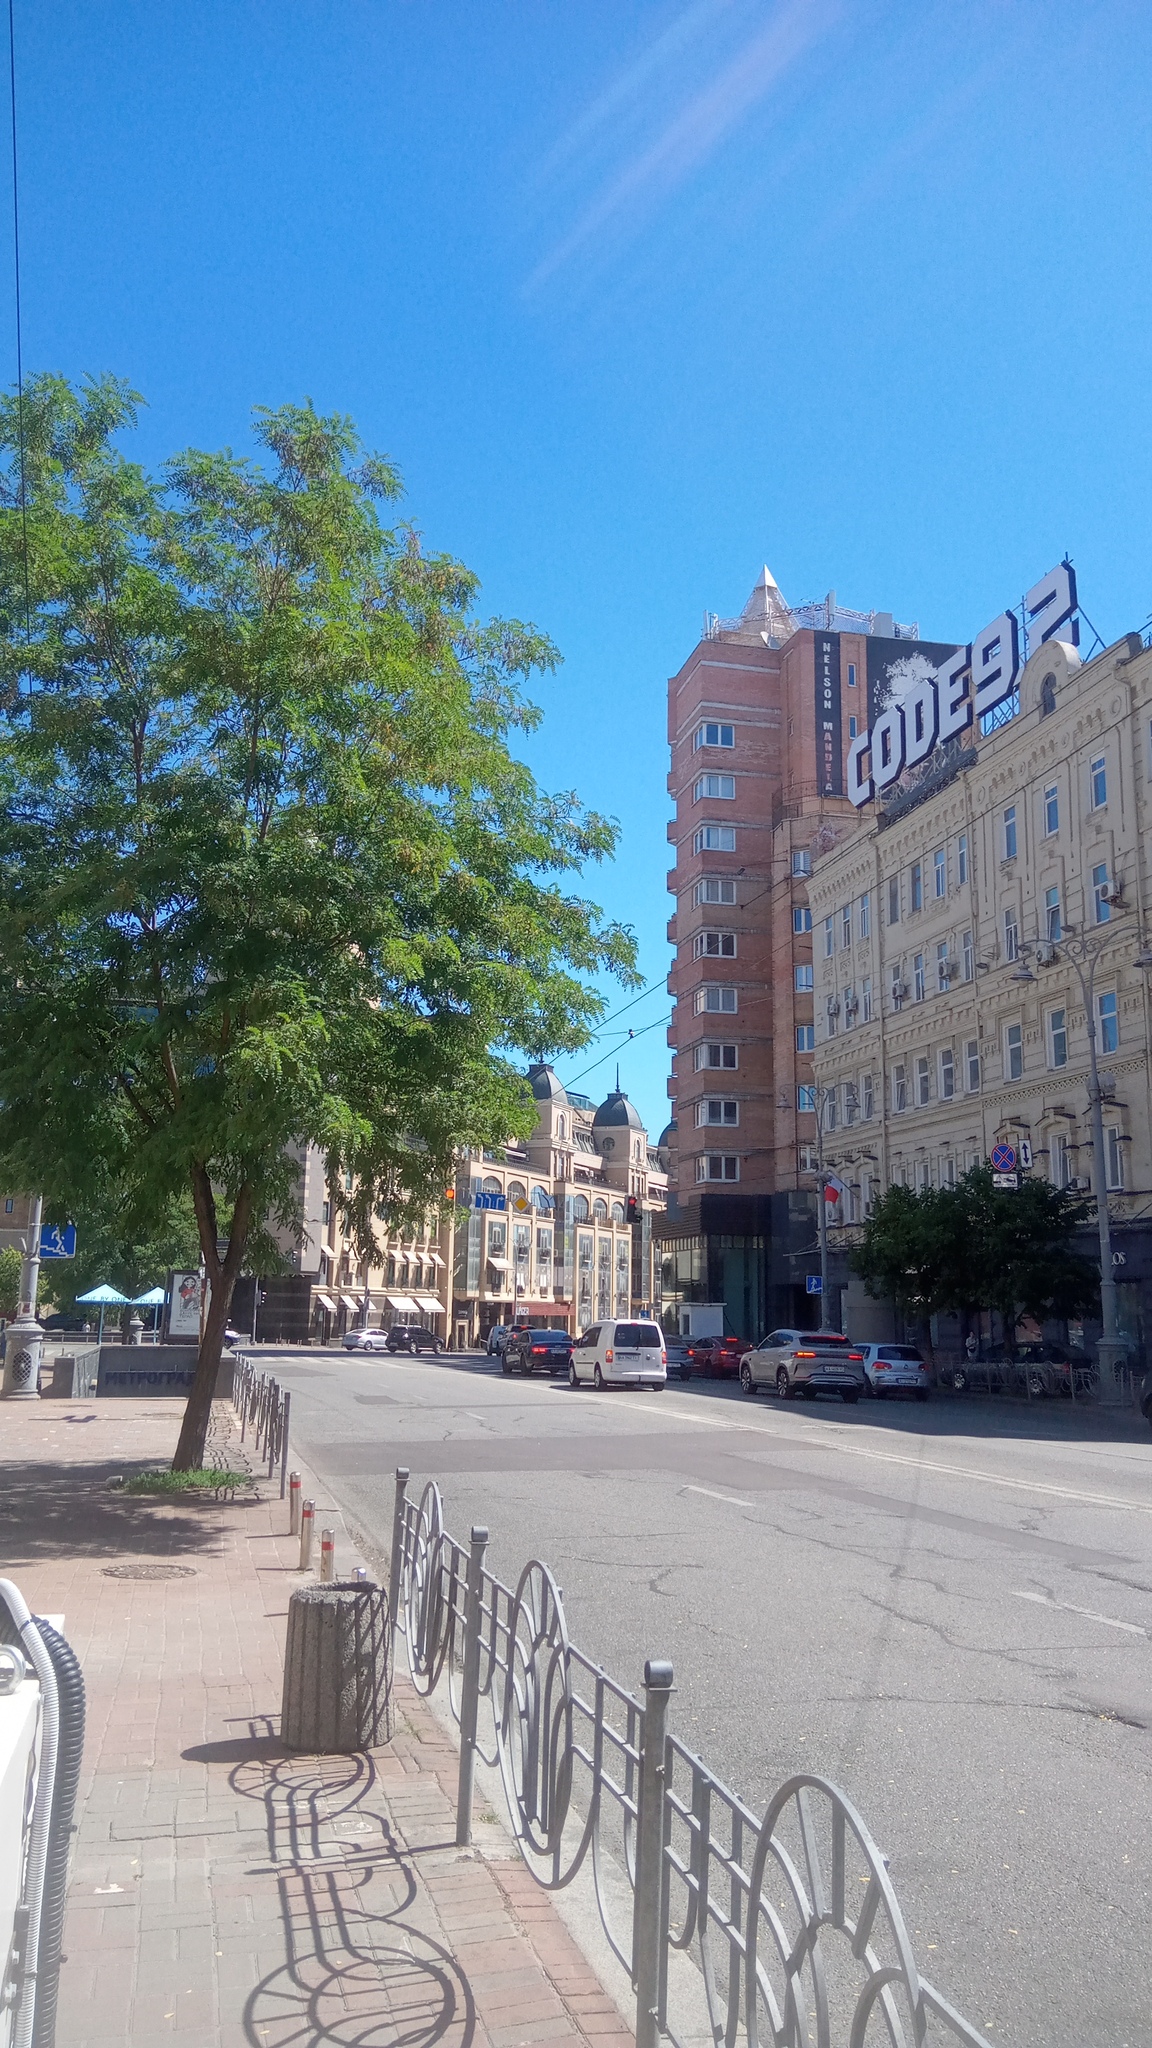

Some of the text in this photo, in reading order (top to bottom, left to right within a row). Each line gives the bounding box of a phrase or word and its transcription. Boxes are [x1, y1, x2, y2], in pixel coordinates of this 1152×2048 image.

[822, 642, 833, 791] NELSON MANDELA
[847, 560, 1079, 810] CODE92
